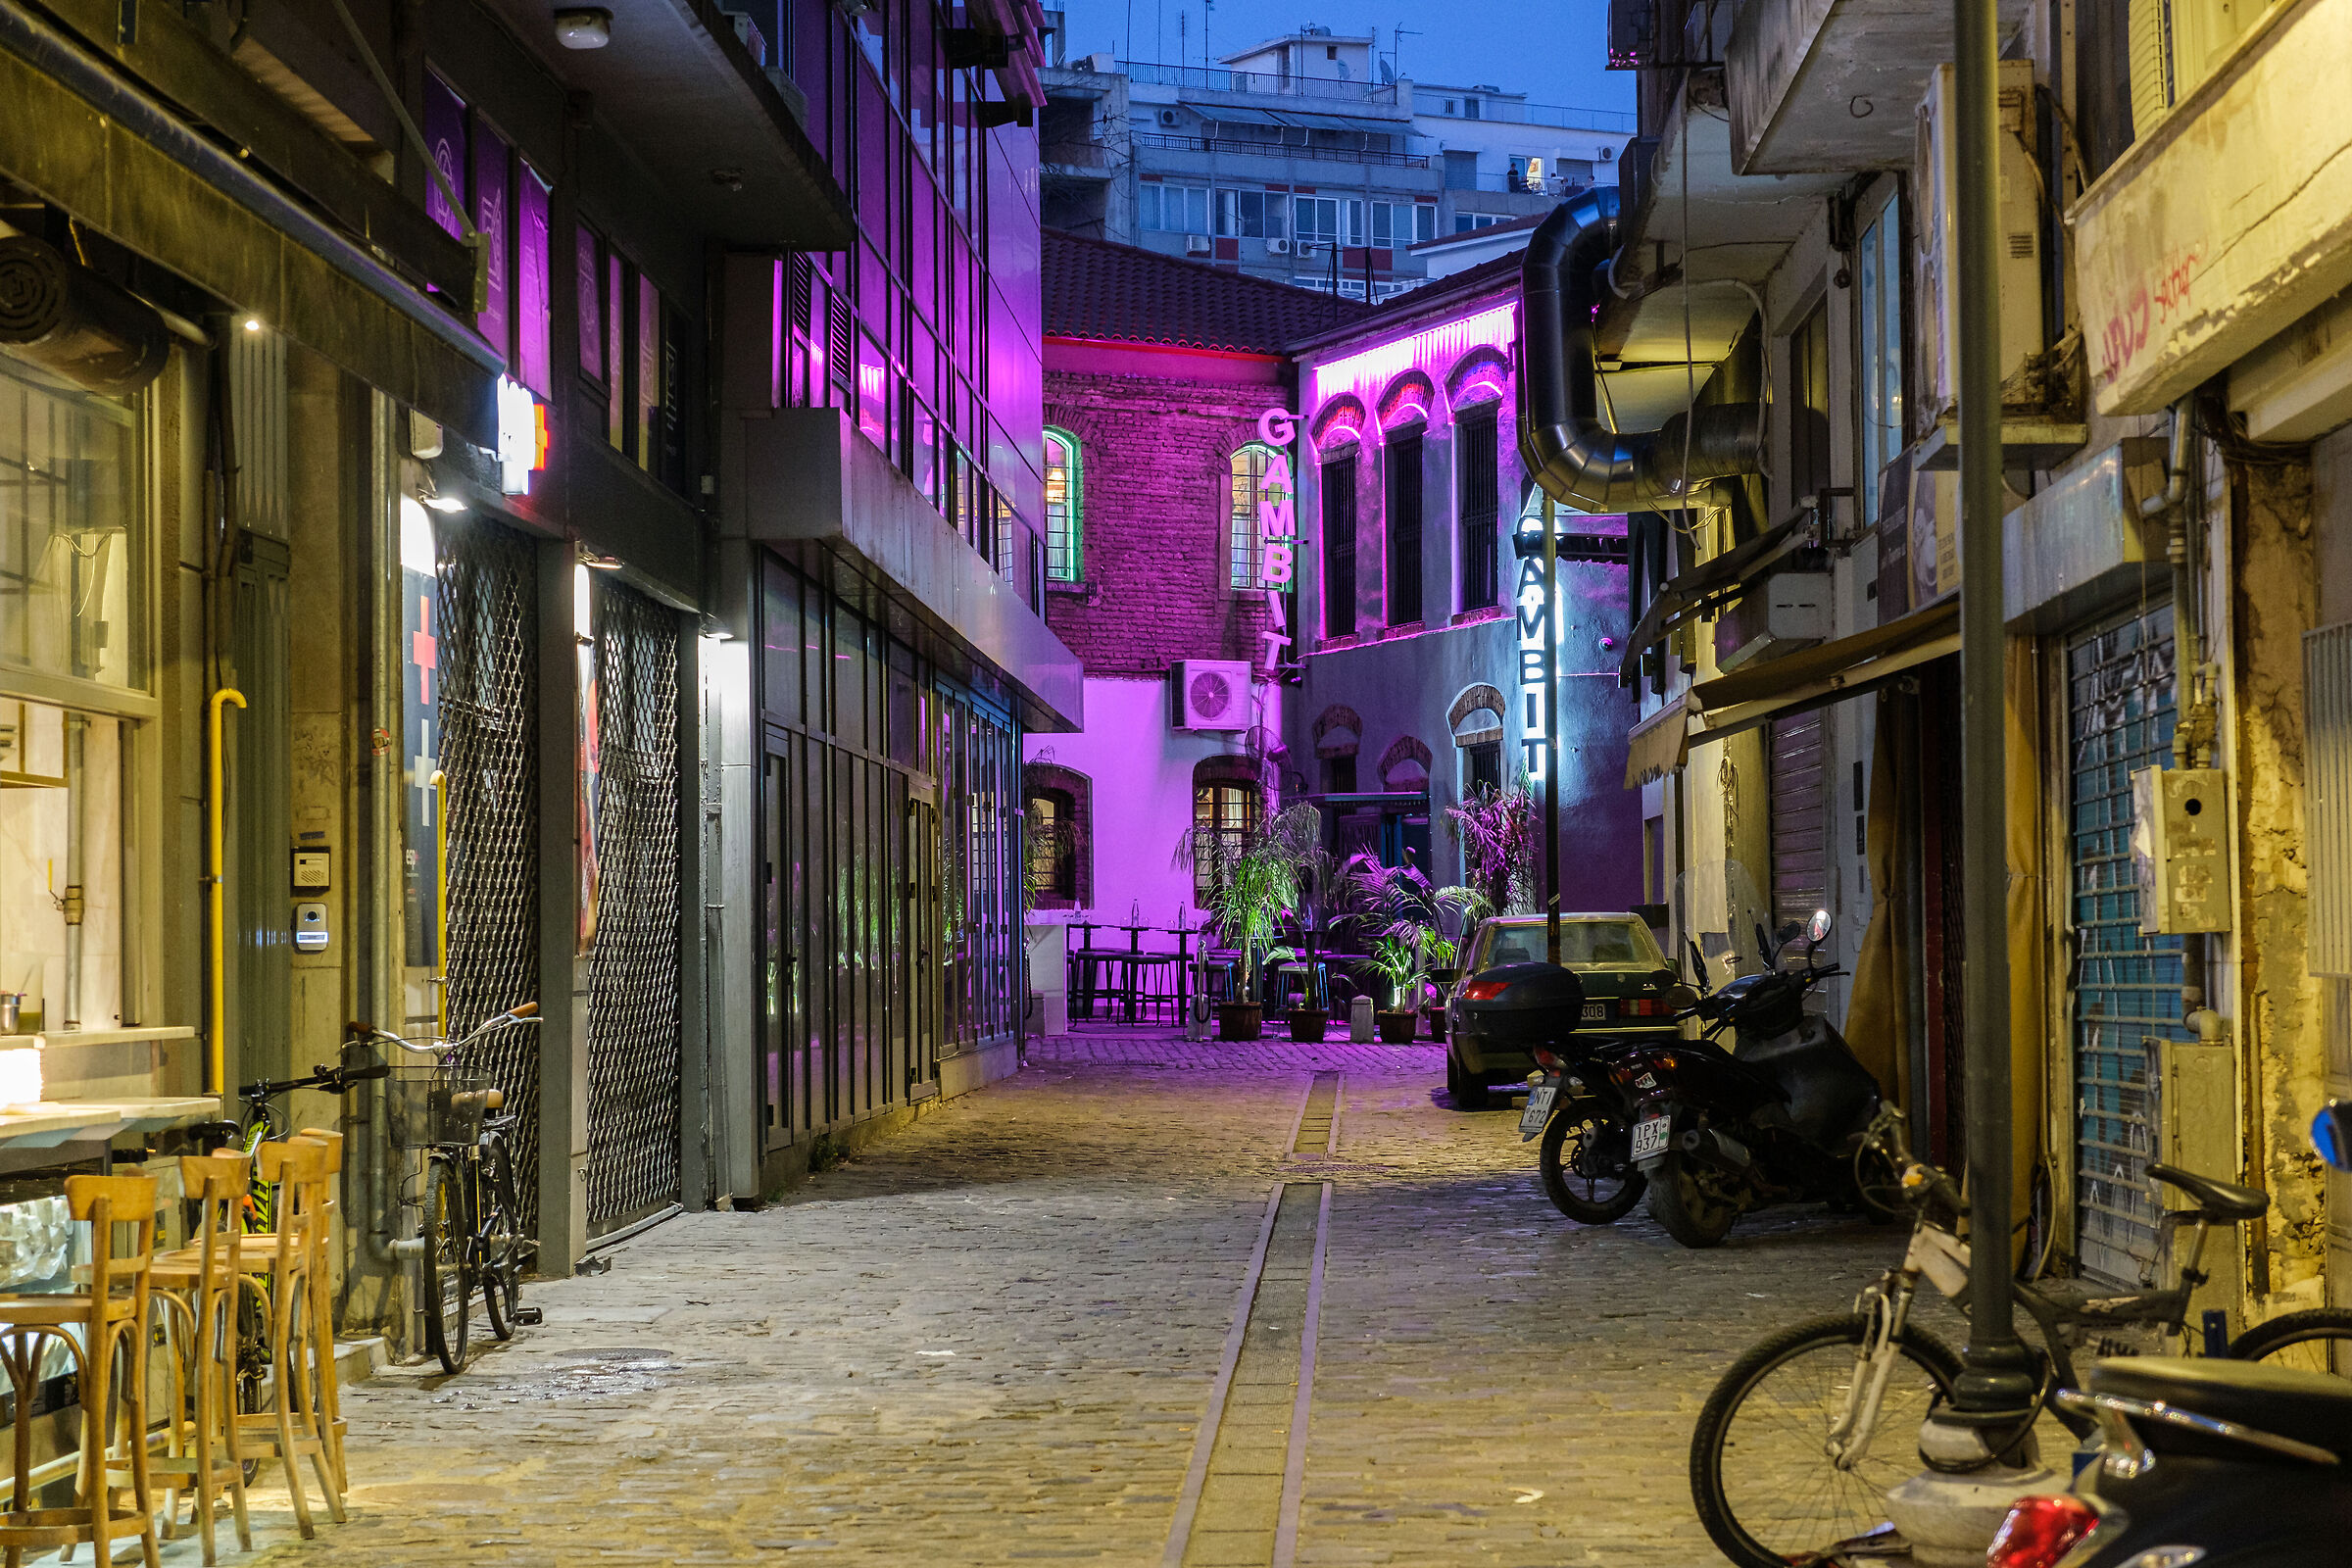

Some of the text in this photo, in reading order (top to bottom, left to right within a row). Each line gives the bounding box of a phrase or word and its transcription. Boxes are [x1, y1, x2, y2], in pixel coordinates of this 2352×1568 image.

[1258, 407, 1296, 670] GAMBIT
[1516, 515, 1548, 772] AMBIT
[1529, 1109, 1546, 1124] 672
[1636, 1135, 1658, 1153] 937
